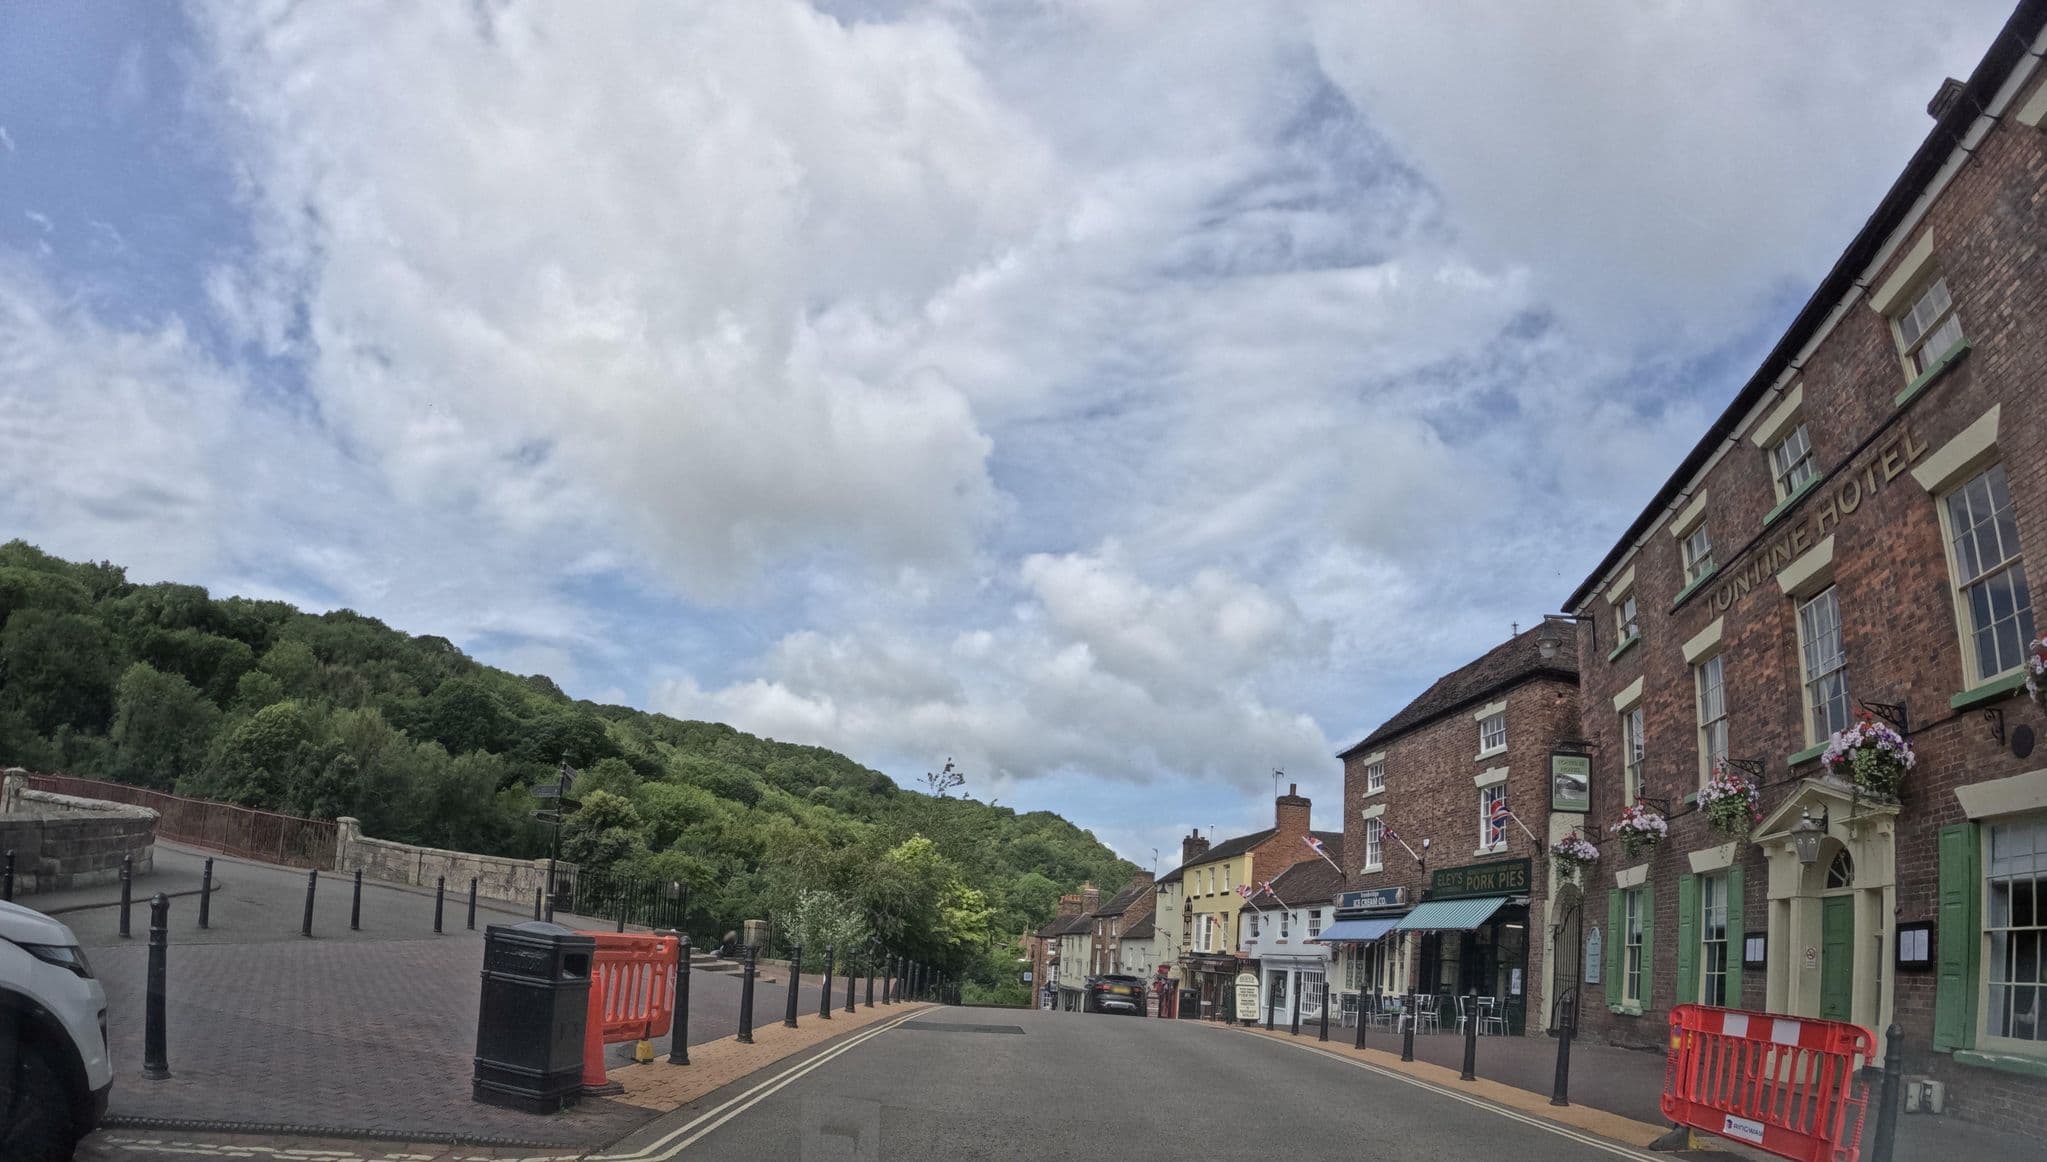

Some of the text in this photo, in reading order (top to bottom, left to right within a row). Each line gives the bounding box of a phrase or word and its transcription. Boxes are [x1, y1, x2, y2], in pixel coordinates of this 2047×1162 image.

[1703, 427, 1929, 620] TONTINE HOTEL
[1436, 870, 1525, 890] ELEY'S PORK PIES
[1733, 1122, 1763, 1137] RINGWAY
